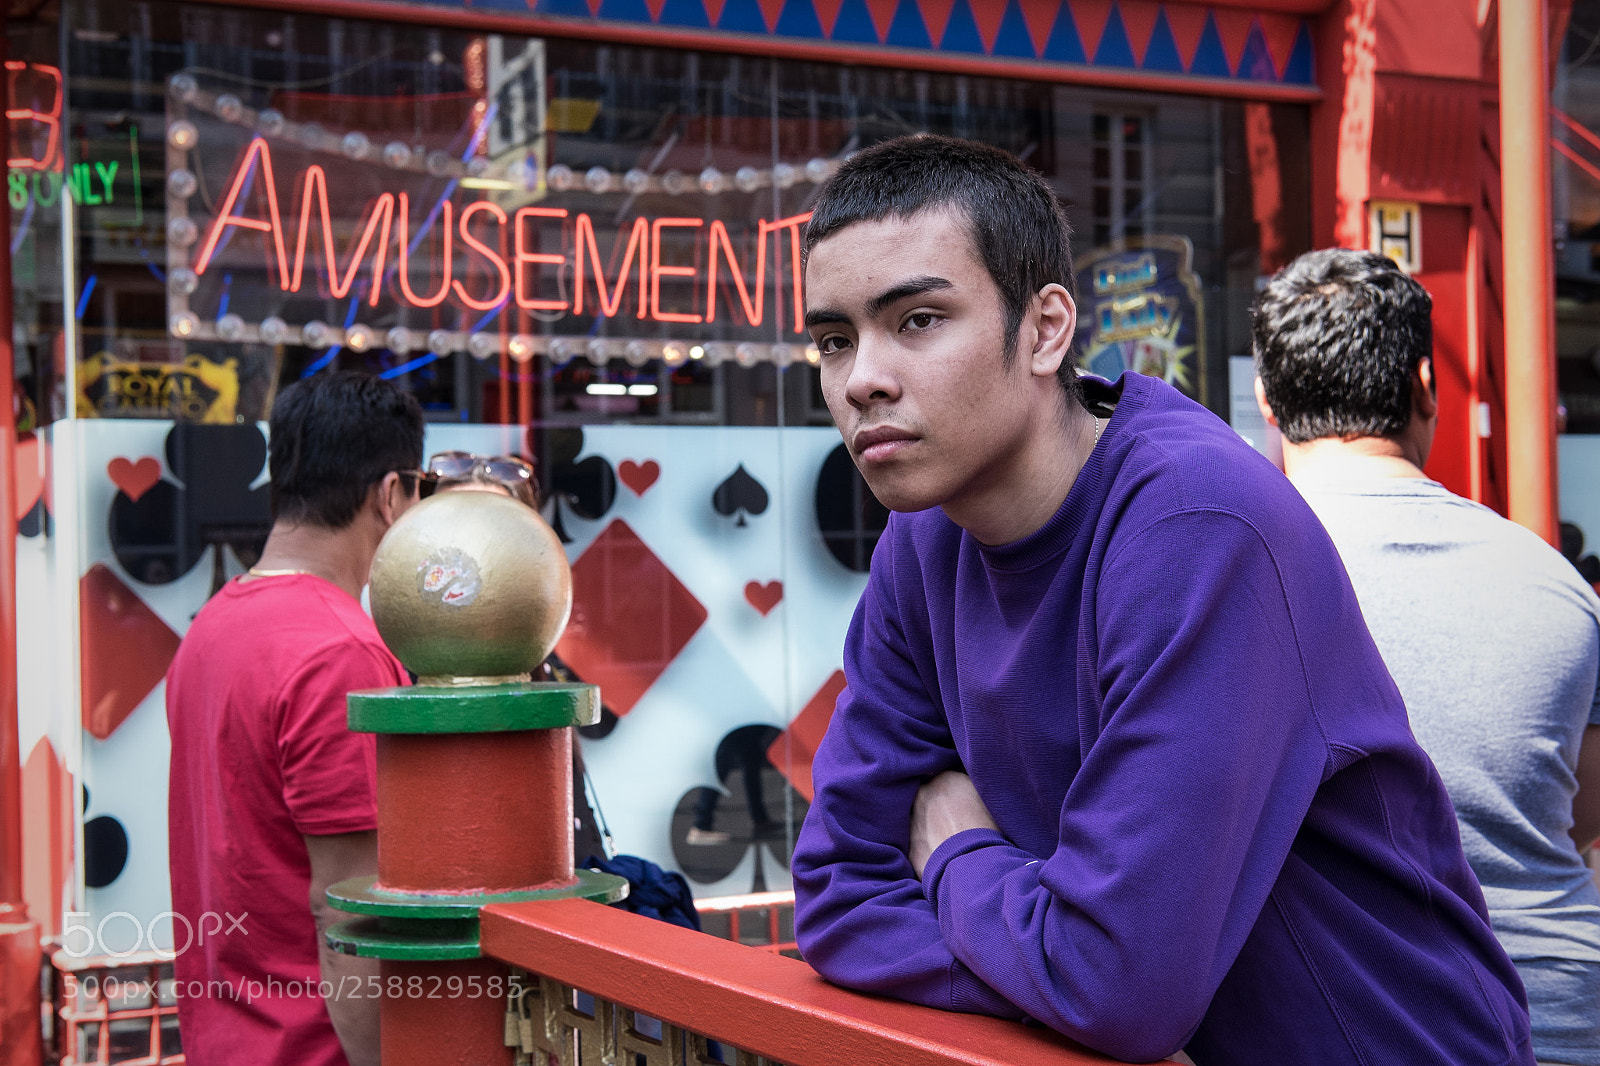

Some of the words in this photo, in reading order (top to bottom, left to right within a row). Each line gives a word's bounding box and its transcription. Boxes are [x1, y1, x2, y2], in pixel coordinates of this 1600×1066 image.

[32, 160, 119, 208] ONLY
[194, 137, 816, 334] AMUSEMENT
[1378, 209, 1412, 265] H
